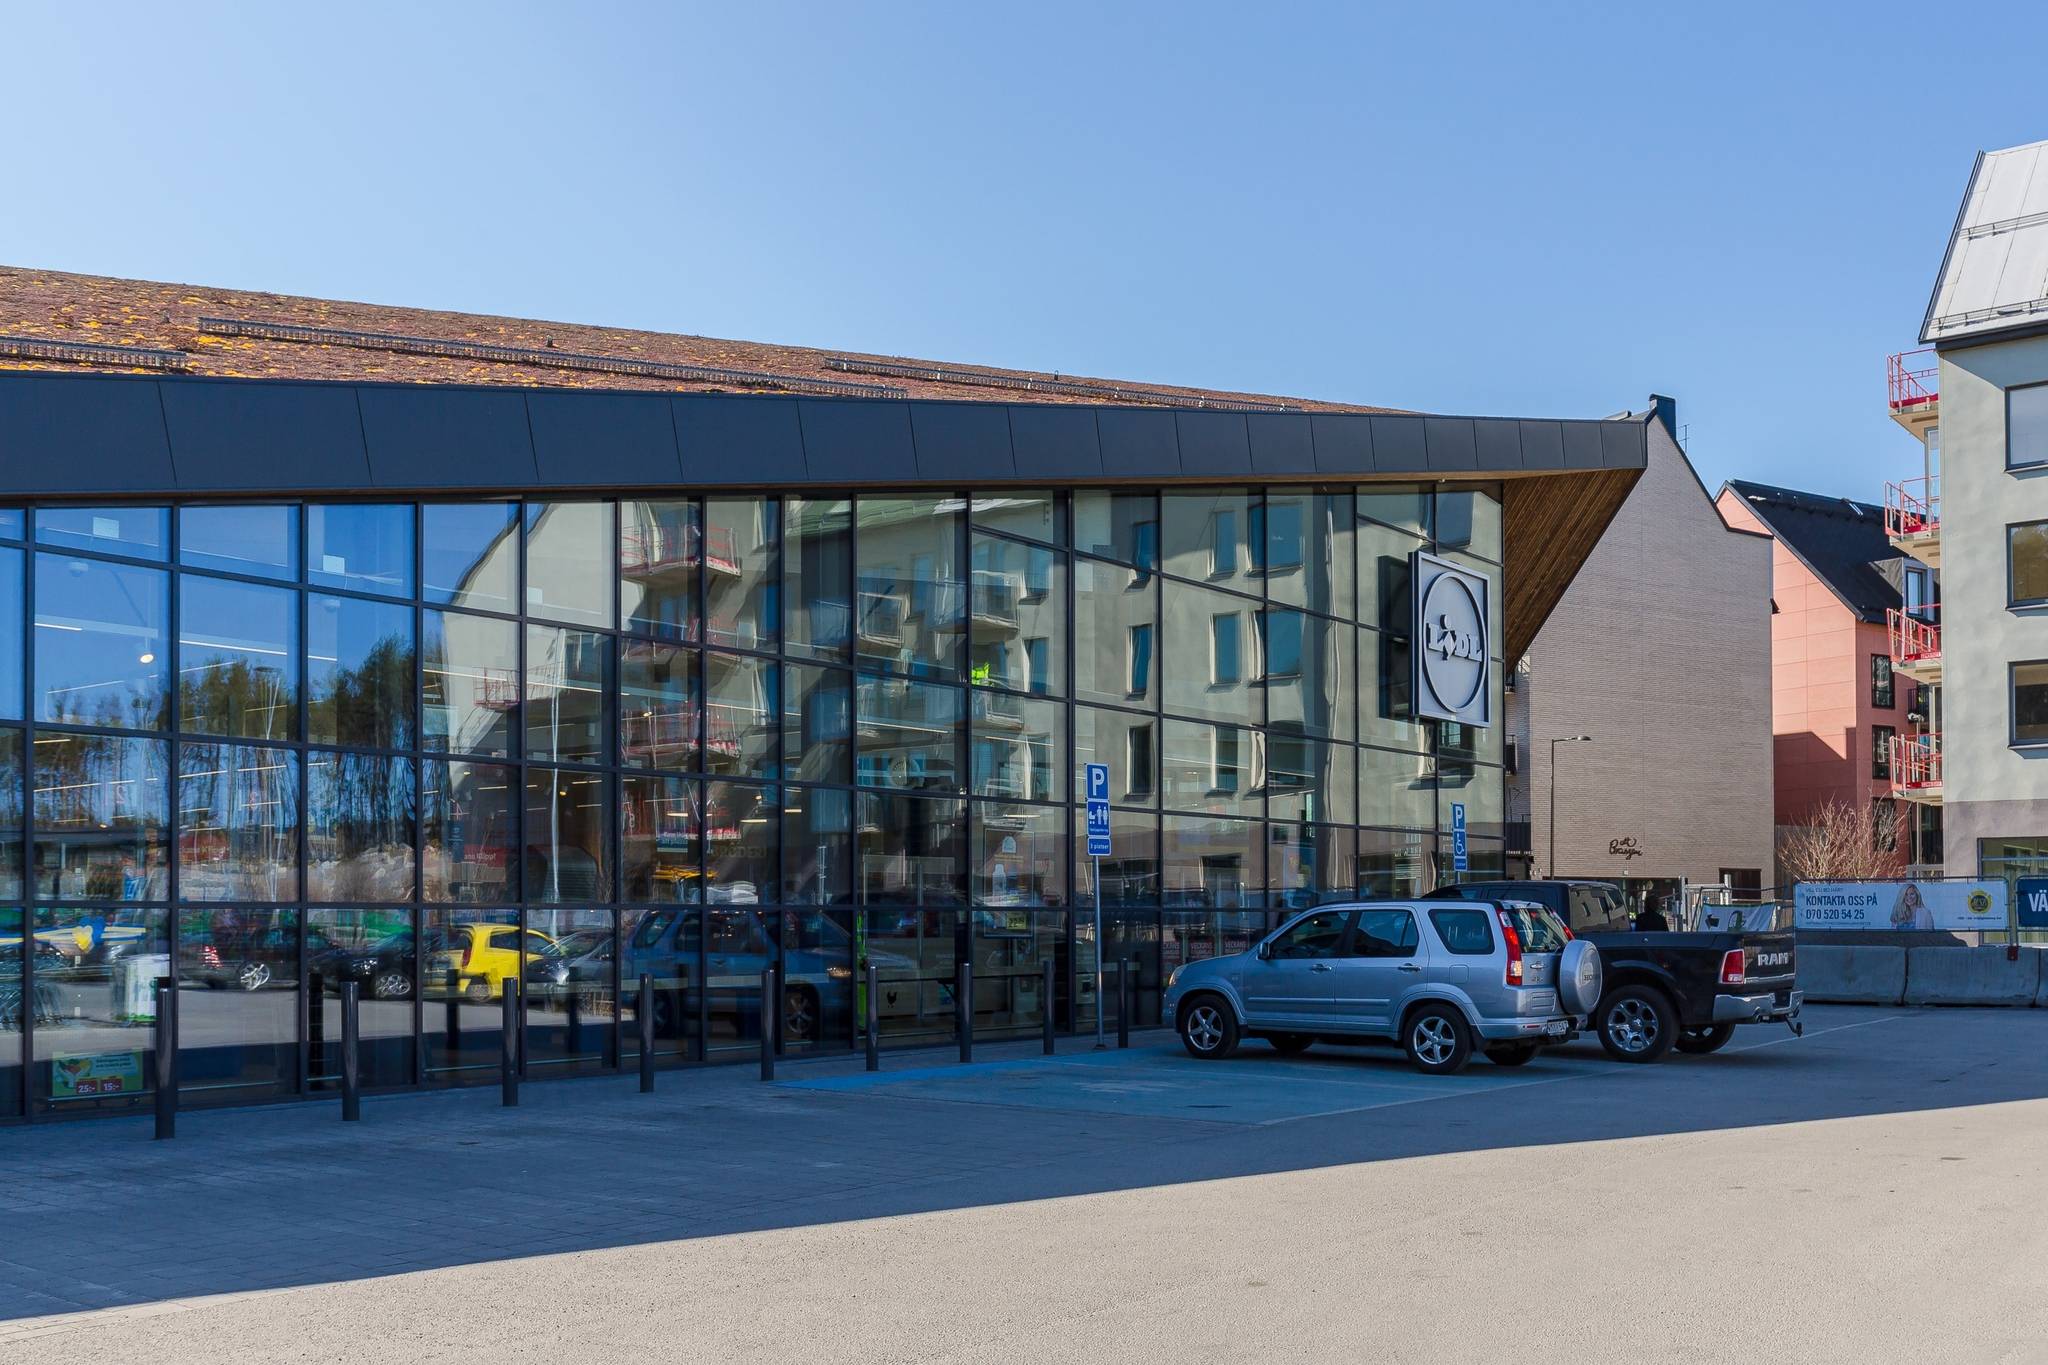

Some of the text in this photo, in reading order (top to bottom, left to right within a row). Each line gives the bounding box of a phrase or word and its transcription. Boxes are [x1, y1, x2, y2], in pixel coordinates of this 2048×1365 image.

[1091, 767, 1105, 796] P
[1455, 805, 1463, 828] P
[1806, 891, 1878, 906] KONTAKTA OSS PÅ
[2028, 889, 2048, 912] VÄ
[1806, 909, 1865, 920] 070 520 54 25
[1758, 952, 1789, 967] RAM
